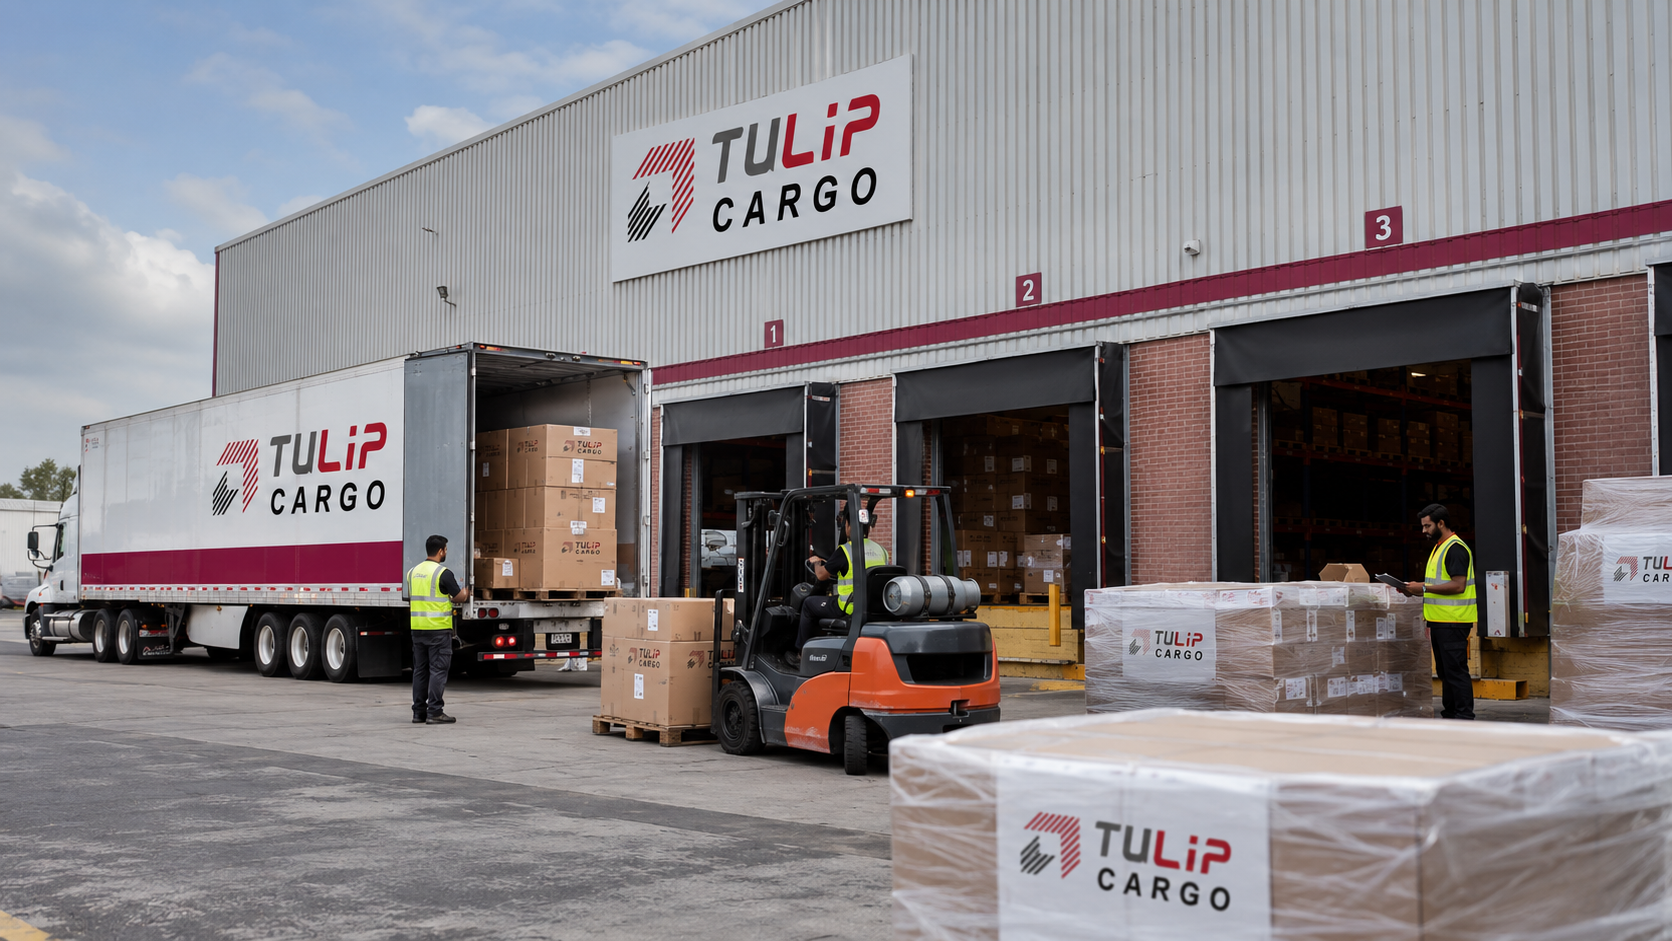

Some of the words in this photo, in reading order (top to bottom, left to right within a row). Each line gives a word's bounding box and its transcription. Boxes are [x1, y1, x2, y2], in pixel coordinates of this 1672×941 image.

[712, 167, 877, 232] CARGO
[1375, 215, 1392, 241] 3
[1022, 279, 1035, 302] 2
[770, 324, 777, 343] 1
[270, 479, 385, 516] CARGO
[1643, 555, 1672, 570] TUL
[1643, 573, 1670, 583] CAR
[1155, 648, 1203, 661] CARGO
[1097, 867, 1231, 912] CARGO
